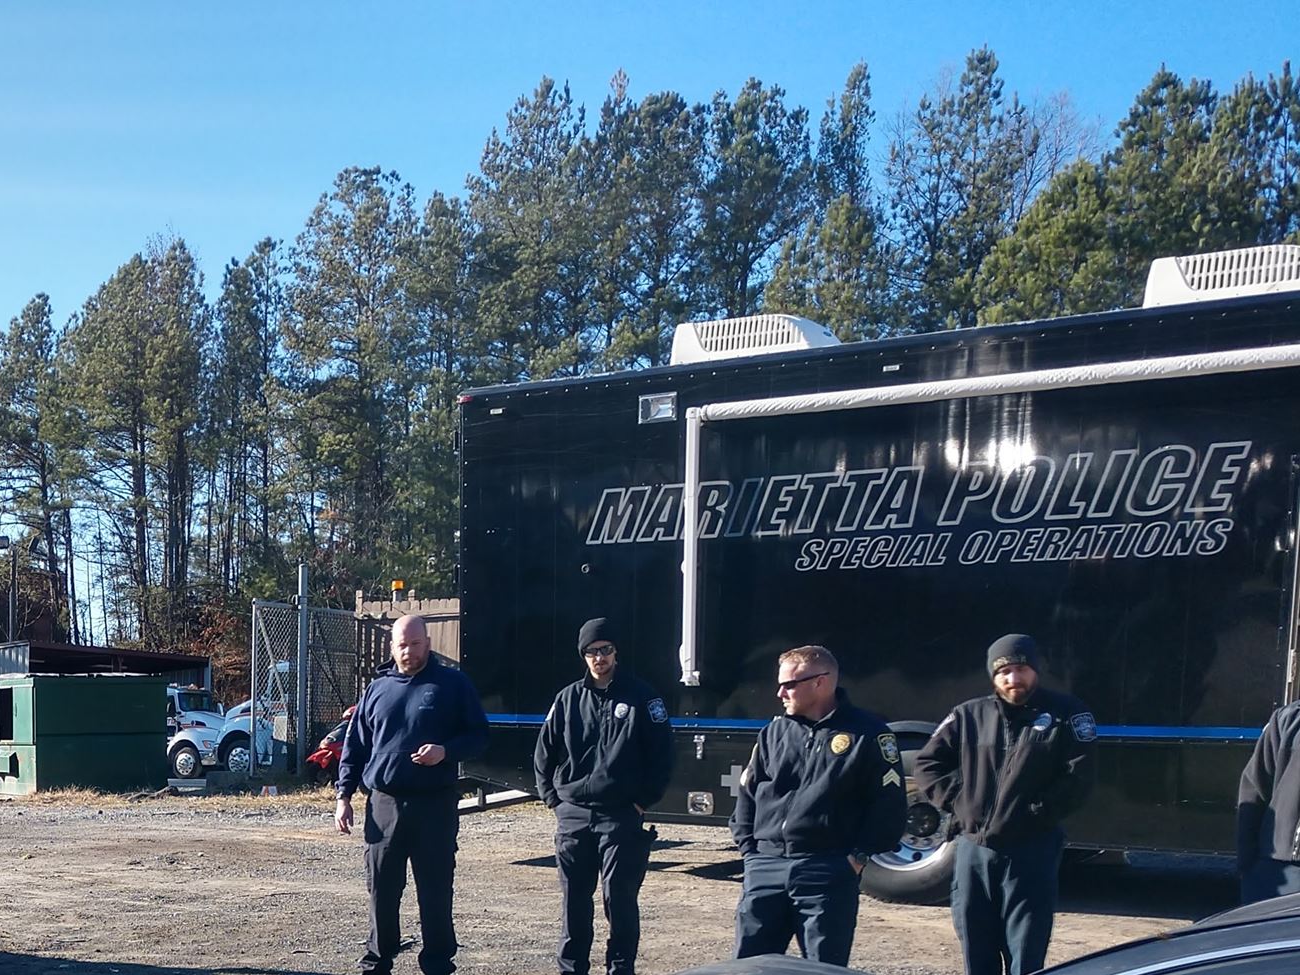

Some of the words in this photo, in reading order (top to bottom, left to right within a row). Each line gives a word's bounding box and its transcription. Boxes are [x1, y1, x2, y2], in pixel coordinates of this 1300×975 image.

[585, 465, 925, 545] MARIETTA
[936, 440, 1253, 527] POLICE
[794, 532, 953, 572] SPECIAL
[958, 518, 1235, 566] OPERATIONS
